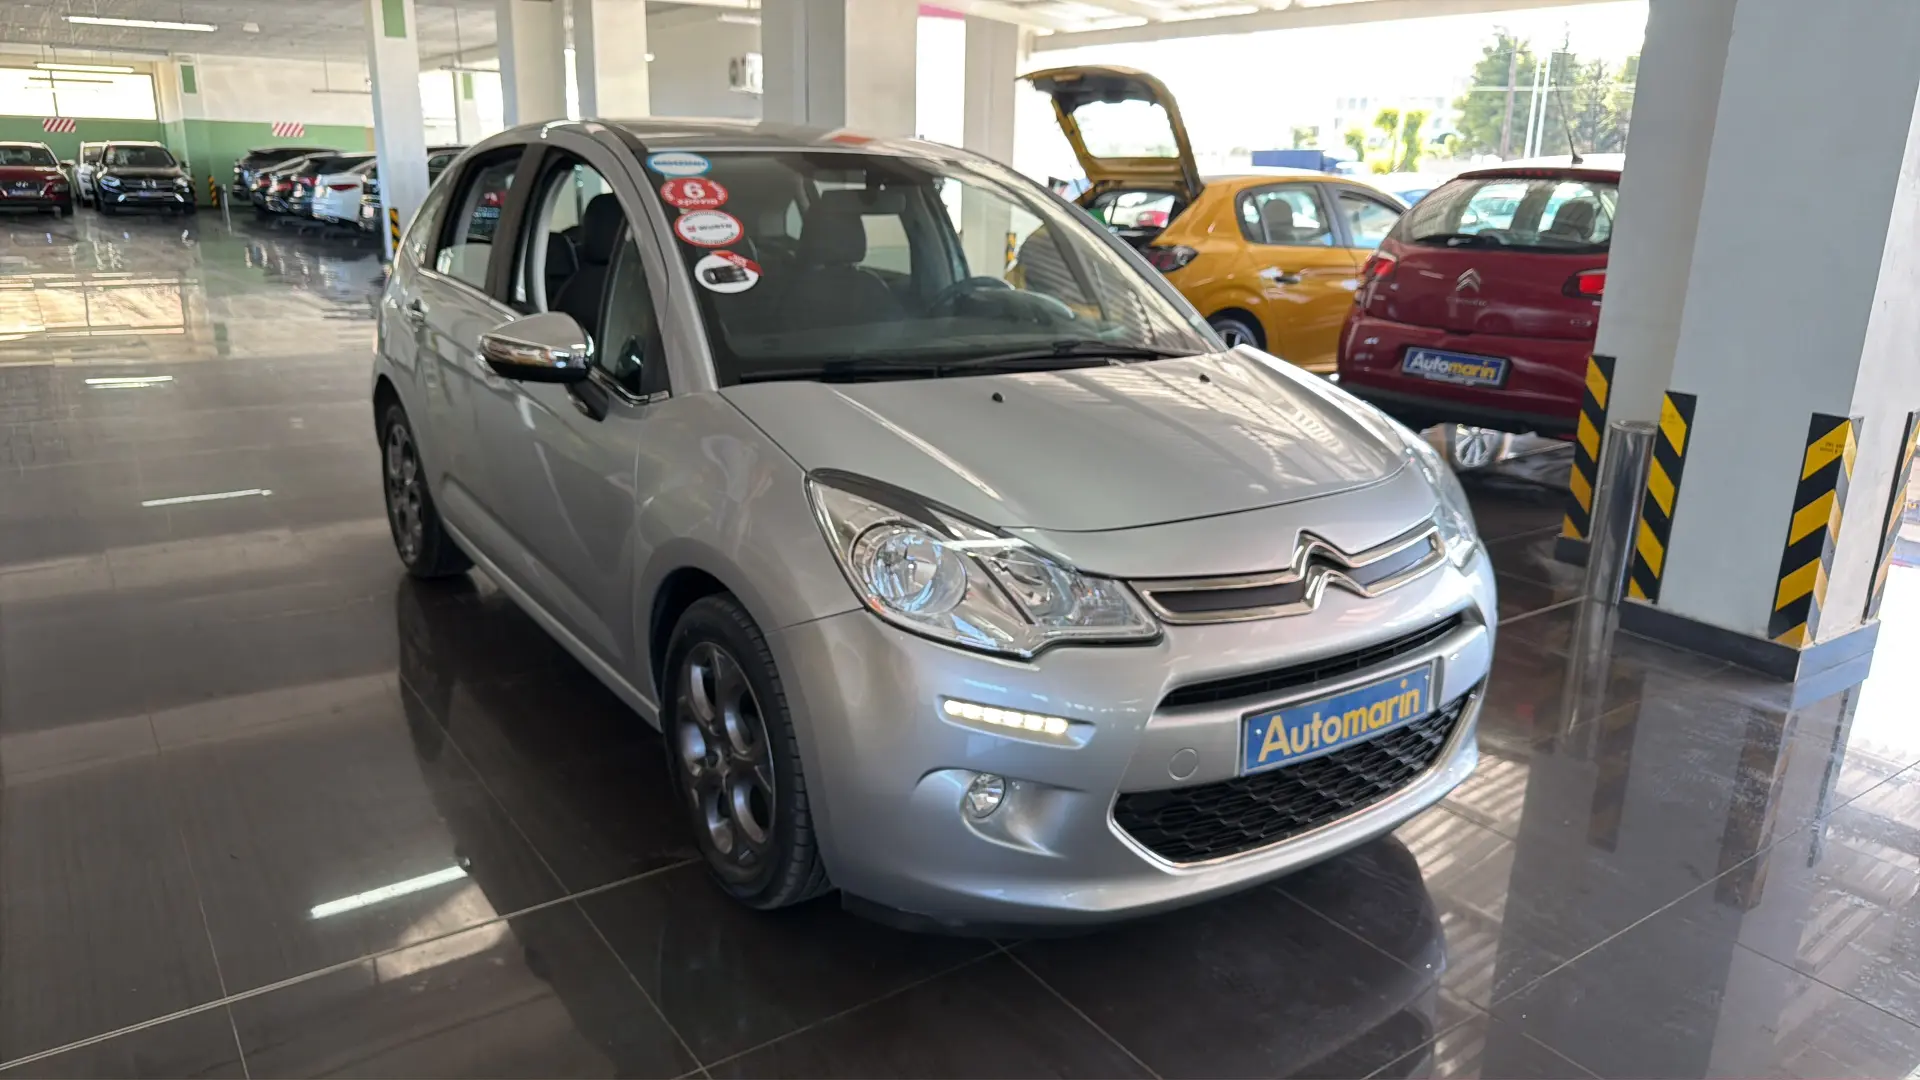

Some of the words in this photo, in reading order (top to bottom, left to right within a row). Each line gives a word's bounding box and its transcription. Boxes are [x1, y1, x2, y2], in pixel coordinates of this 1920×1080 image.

[683, 182, 705, 199] 6
[1410, 350, 1497, 380] Automarin
[1257, 678, 1421, 763] Automarin
